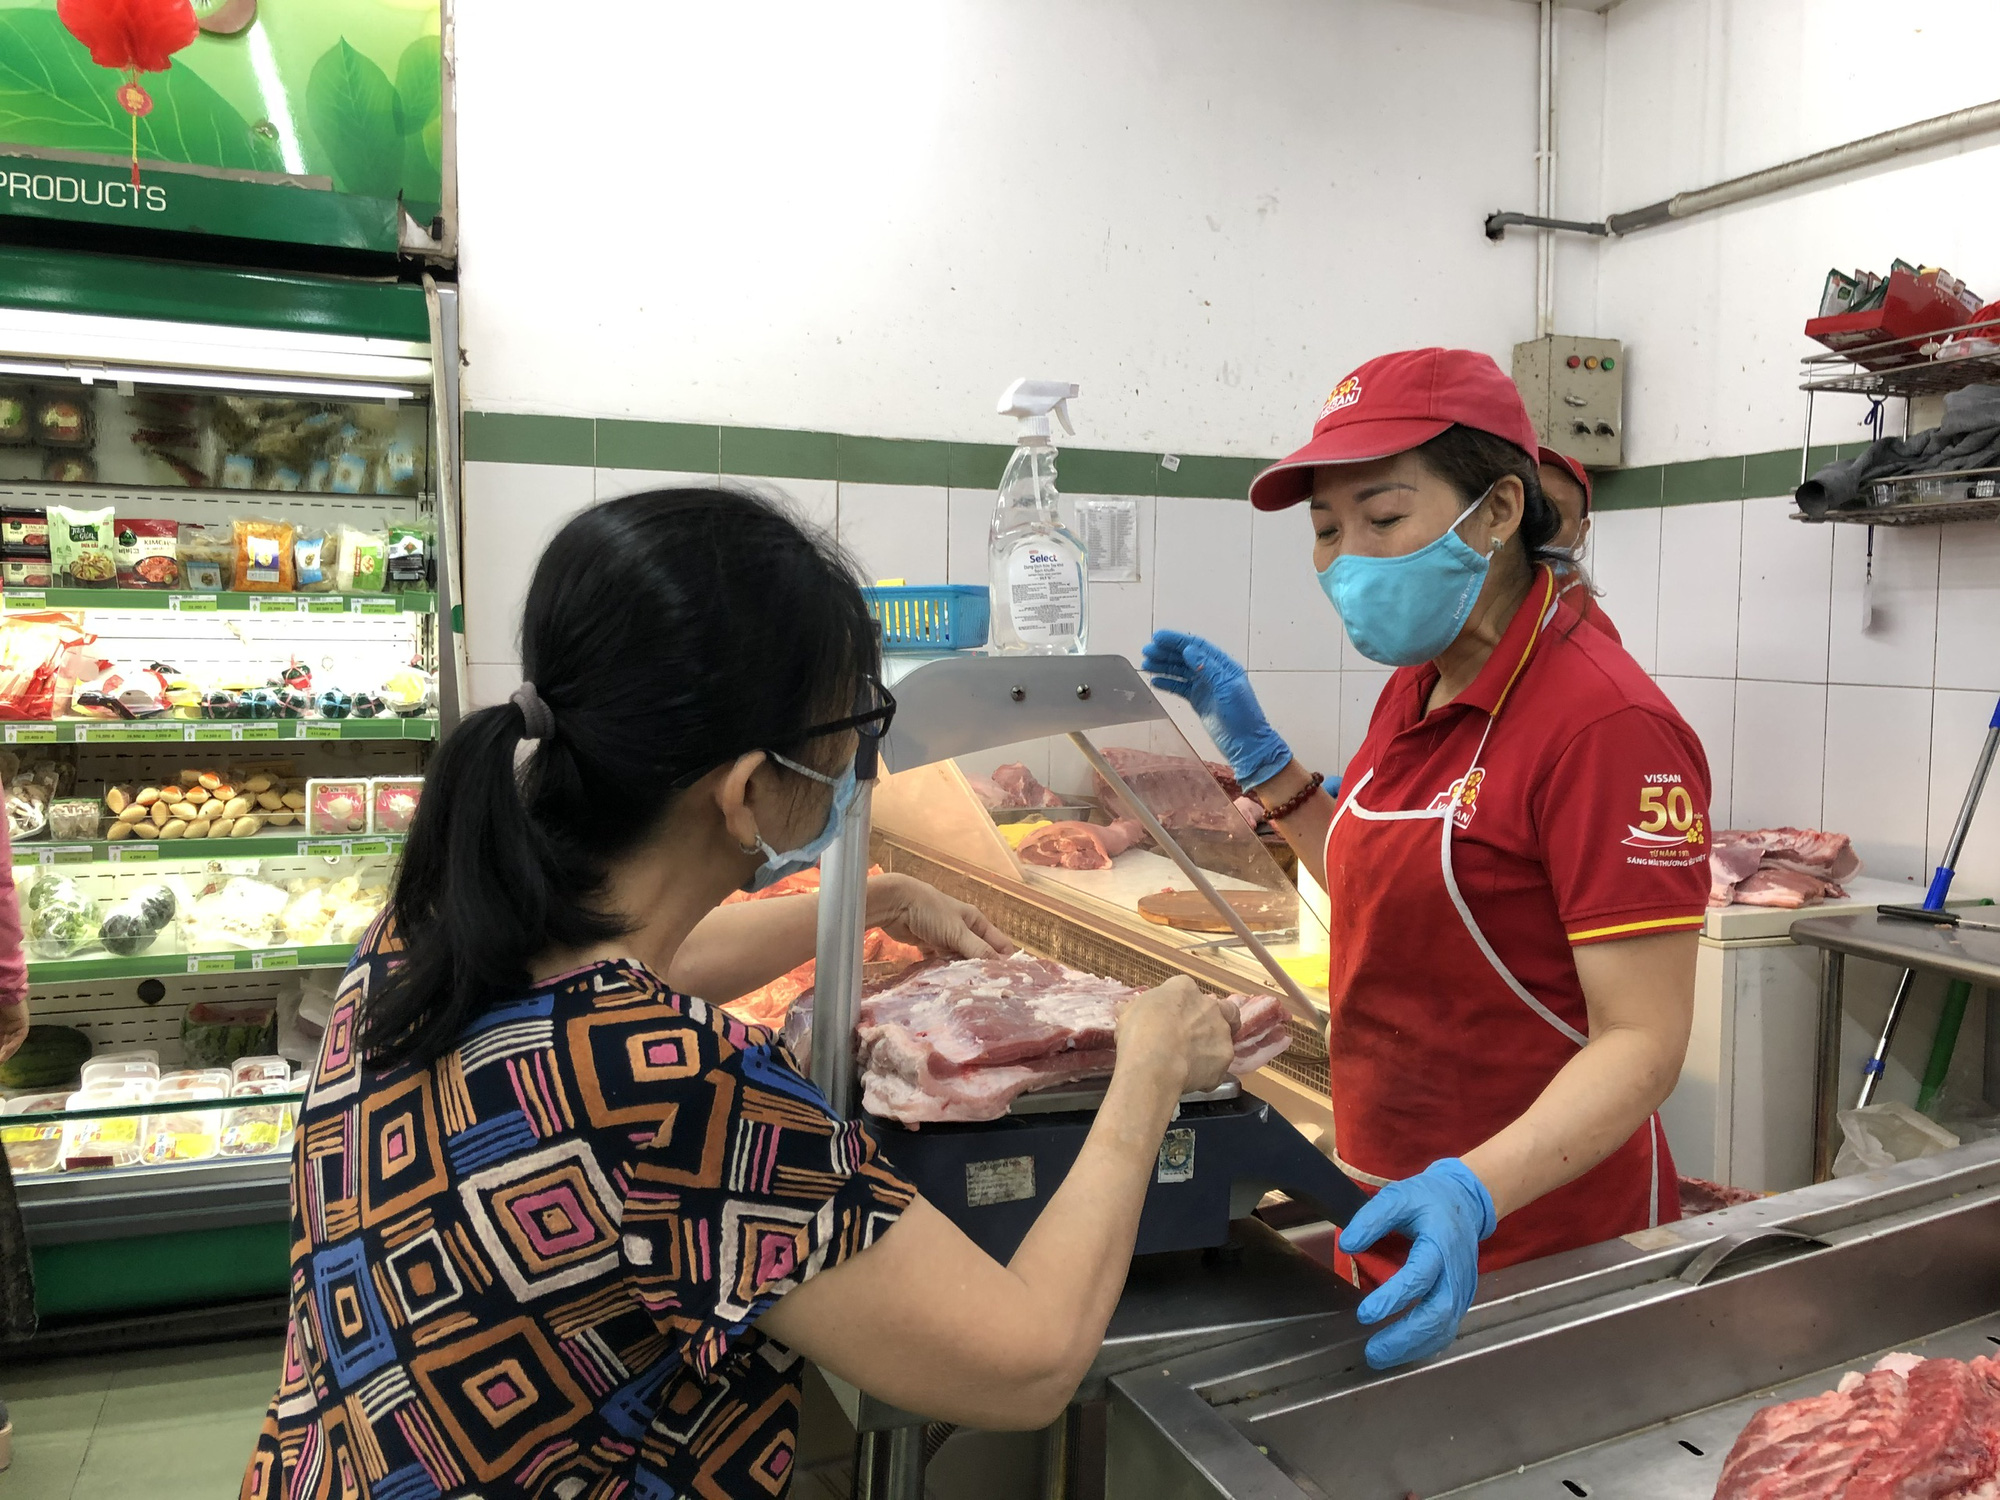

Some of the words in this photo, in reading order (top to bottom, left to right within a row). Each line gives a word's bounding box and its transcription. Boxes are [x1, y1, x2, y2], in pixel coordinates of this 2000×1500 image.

[1029, 554, 1058, 563] Select
[1644, 774, 1682, 784] VISSAN
[1437, 801, 1471, 823] VIAN
[1639, 786, 1693, 832] 50
